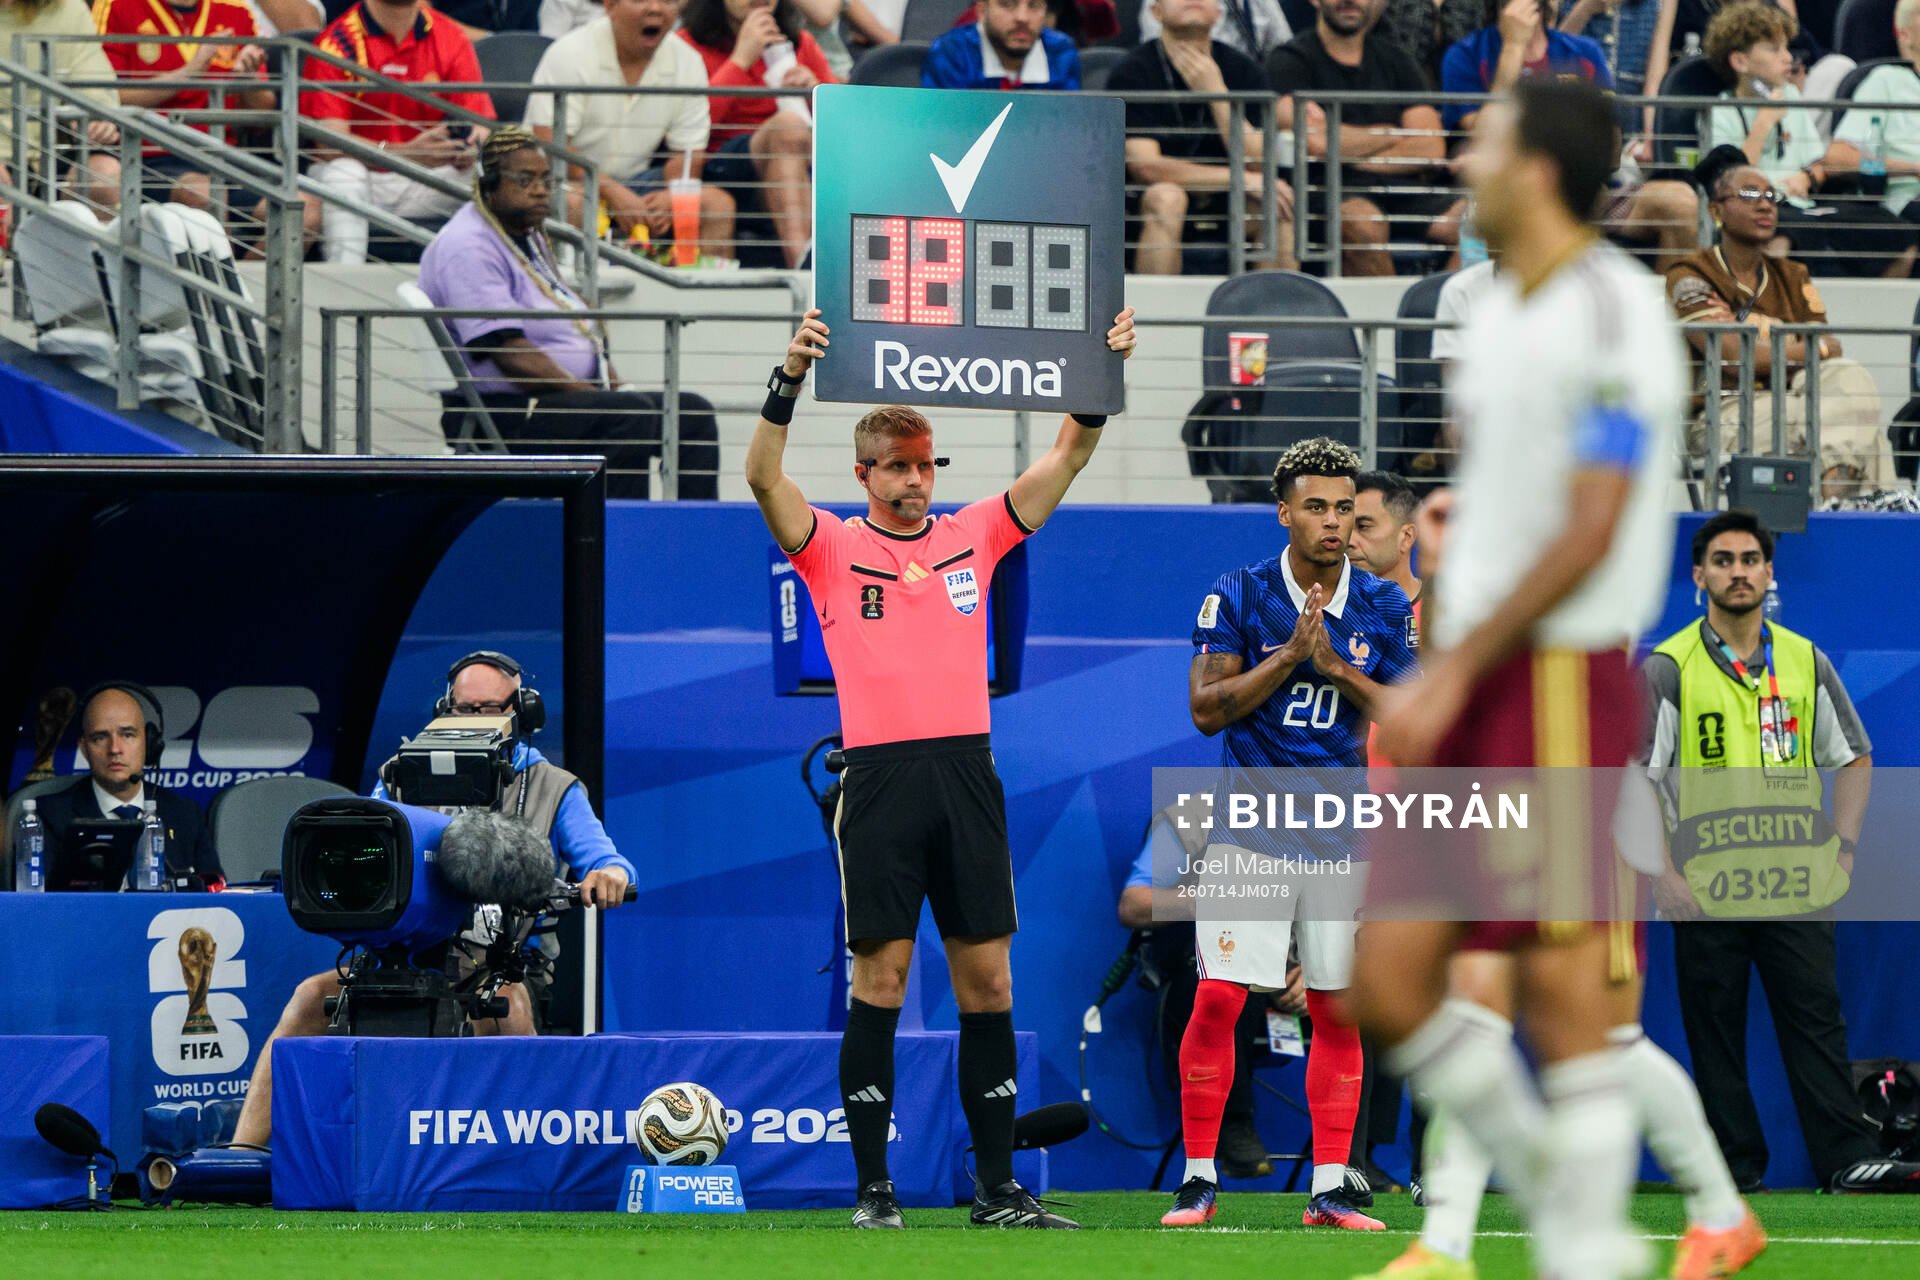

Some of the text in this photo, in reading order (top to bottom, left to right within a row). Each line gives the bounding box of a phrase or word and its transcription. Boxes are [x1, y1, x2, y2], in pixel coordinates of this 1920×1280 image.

[886, 217, 966, 325] 12
[947, 571, 974, 586] FIFA
[952, 588, 977, 599] REFEREE
[1283, 681, 1340, 729] 20
[191, 772, 233, 788] CUP
[1766, 780, 1809, 791] FIFA.com
[1696, 813, 1813, 850] SECURITY
[180, 1042, 224, 1060] FIFA
[154, 1080, 250, 1099] WORLD CUP
[409, 1110, 498, 1145] FIFA
[659, 1176, 733, 1191] POWER
